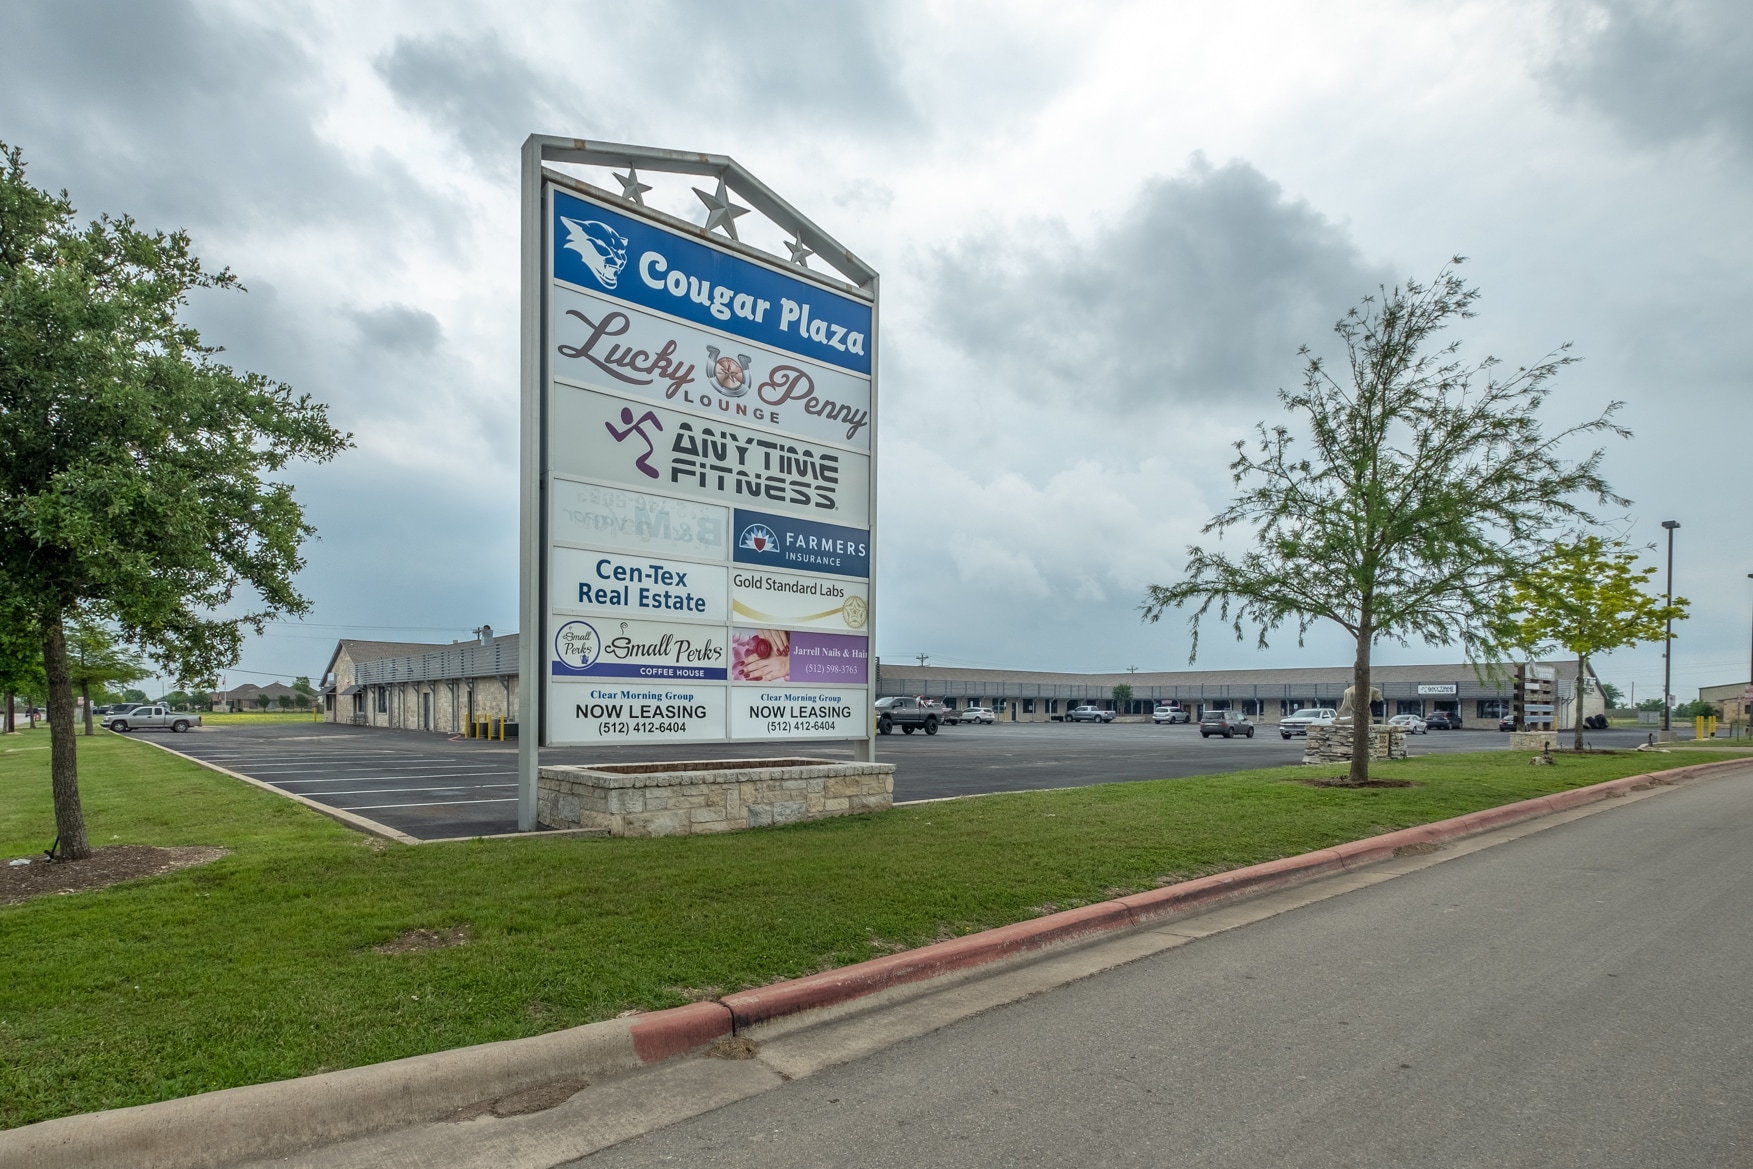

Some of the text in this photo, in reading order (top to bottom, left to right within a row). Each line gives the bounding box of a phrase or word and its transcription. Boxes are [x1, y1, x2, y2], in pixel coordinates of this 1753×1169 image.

[639, 251, 865, 356] Cougar Plaza
[557, 309, 868, 440] Lucky Penny
[684, 390, 780, 425] LOUNGE
[671, 422, 839, 485] ANYTIME
[670, 457, 837, 511] FITNESS
[786, 532, 866, 558] FARMERS
[786, 551, 841, 567] INSURANCE
[595, 559, 688, 588] Cen-Tex
[733, 574, 845, 598] Gold Standard Labs
[578, 582, 707, 613] Real Estate
[562, 631, 593, 642] Small
[563, 642, 593, 656] Perks
[604, 633, 723, 664] Small Perks
[793, 646, 820, 657] Jarrell
[822, 647, 841, 658] Nails
[842, 648, 850, 658] &
[639, 667, 705, 678] COFFEE HOUSE
[805, 664, 858, 675] (512) 598-3763
[590, 690, 694, 702] Clear Morning Group
[760, 693, 842, 704] Clear Morning Group
[576, 704, 707, 719] NOW LEASING
[749, 706, 851, 718] NOW LEASING
[599, 722, 687, 736] (512) 412-6404
[767, 721, 835, 733] (512) 412-6404
